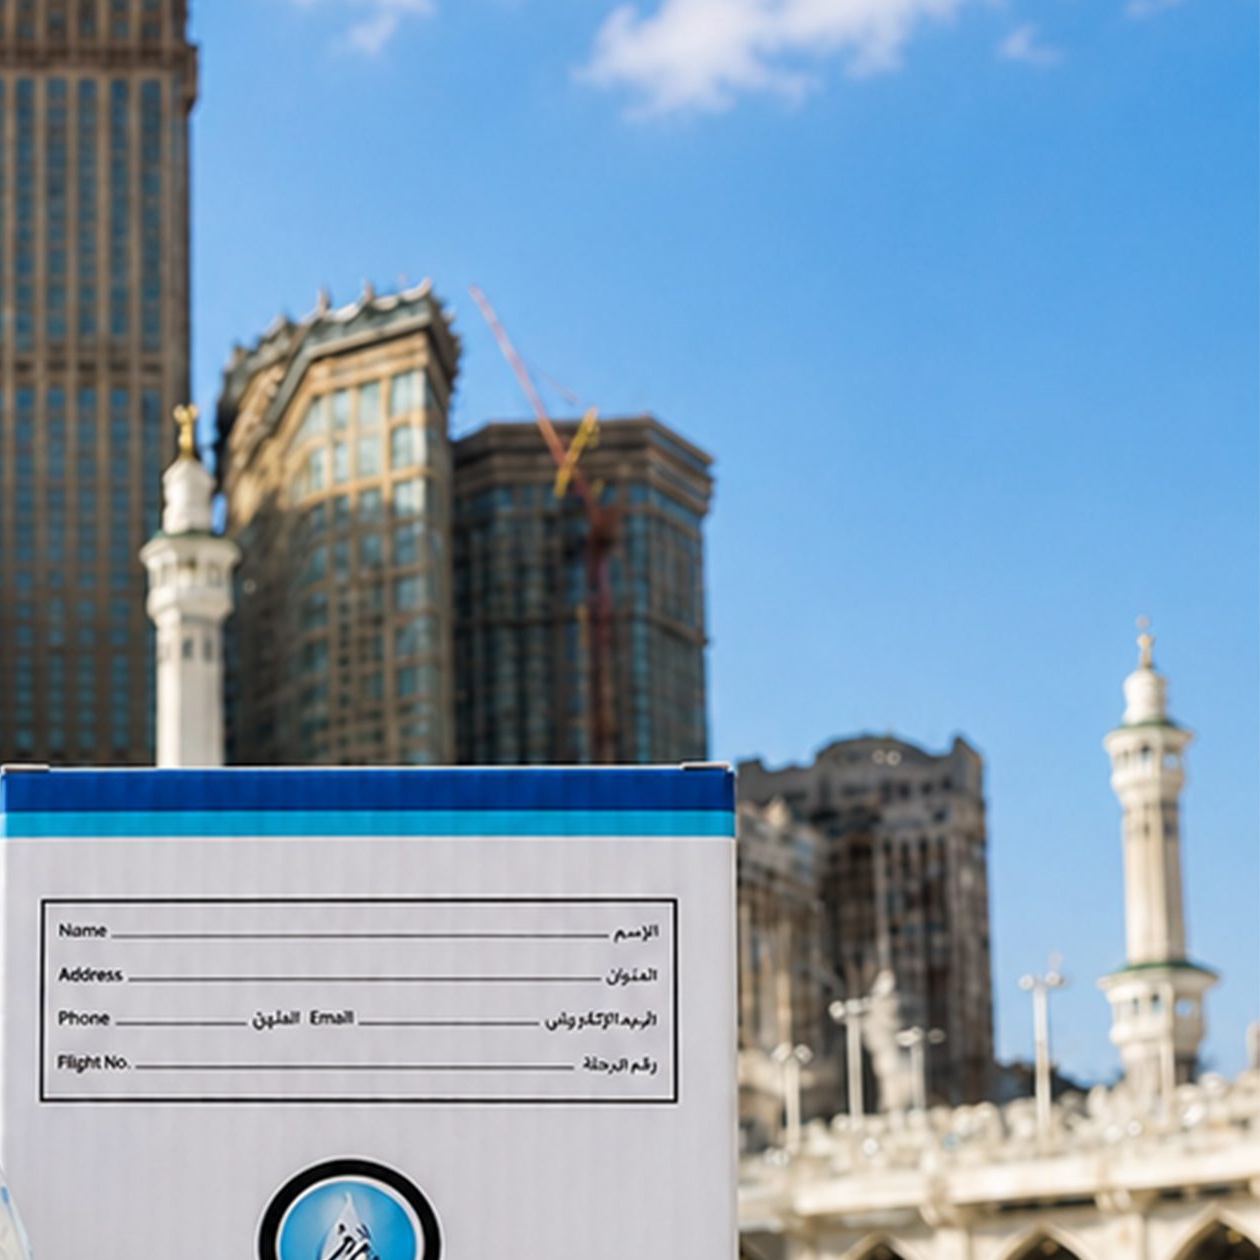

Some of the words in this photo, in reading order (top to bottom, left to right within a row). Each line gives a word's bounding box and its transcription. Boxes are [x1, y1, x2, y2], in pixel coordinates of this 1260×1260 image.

[58, 923, 107, 938] Name
[58, 967, 123, 983] Address
[58, 1010, 110, 1026] Phone
[57, 1054, 102, 1074] Flight
[104, 1055, 131, 1070] No.
